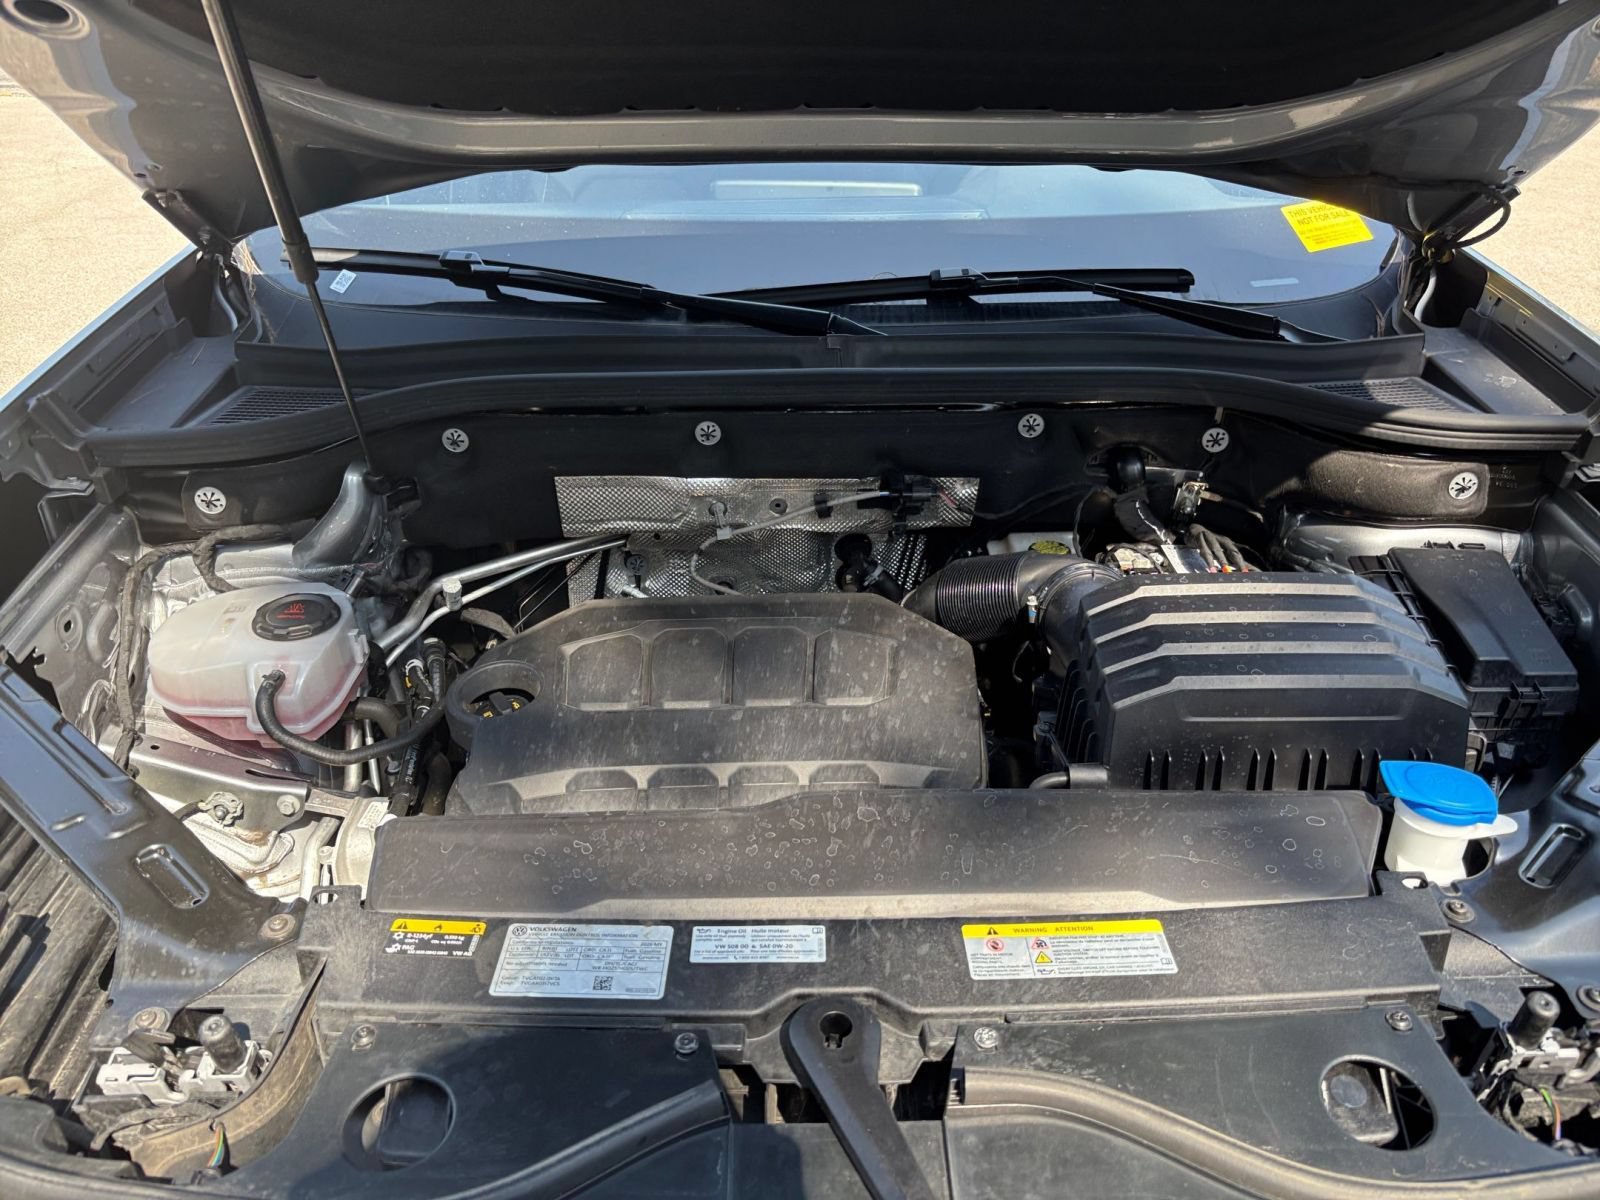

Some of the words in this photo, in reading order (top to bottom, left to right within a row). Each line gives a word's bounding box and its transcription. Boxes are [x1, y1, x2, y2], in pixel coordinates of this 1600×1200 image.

[1288, 208, 1307, 218] THIS
[1297, 217, 1313, 226] NOT
[1314, 213, 1329, 222] FOR
[1330, 209, 1352, 218] SALE
